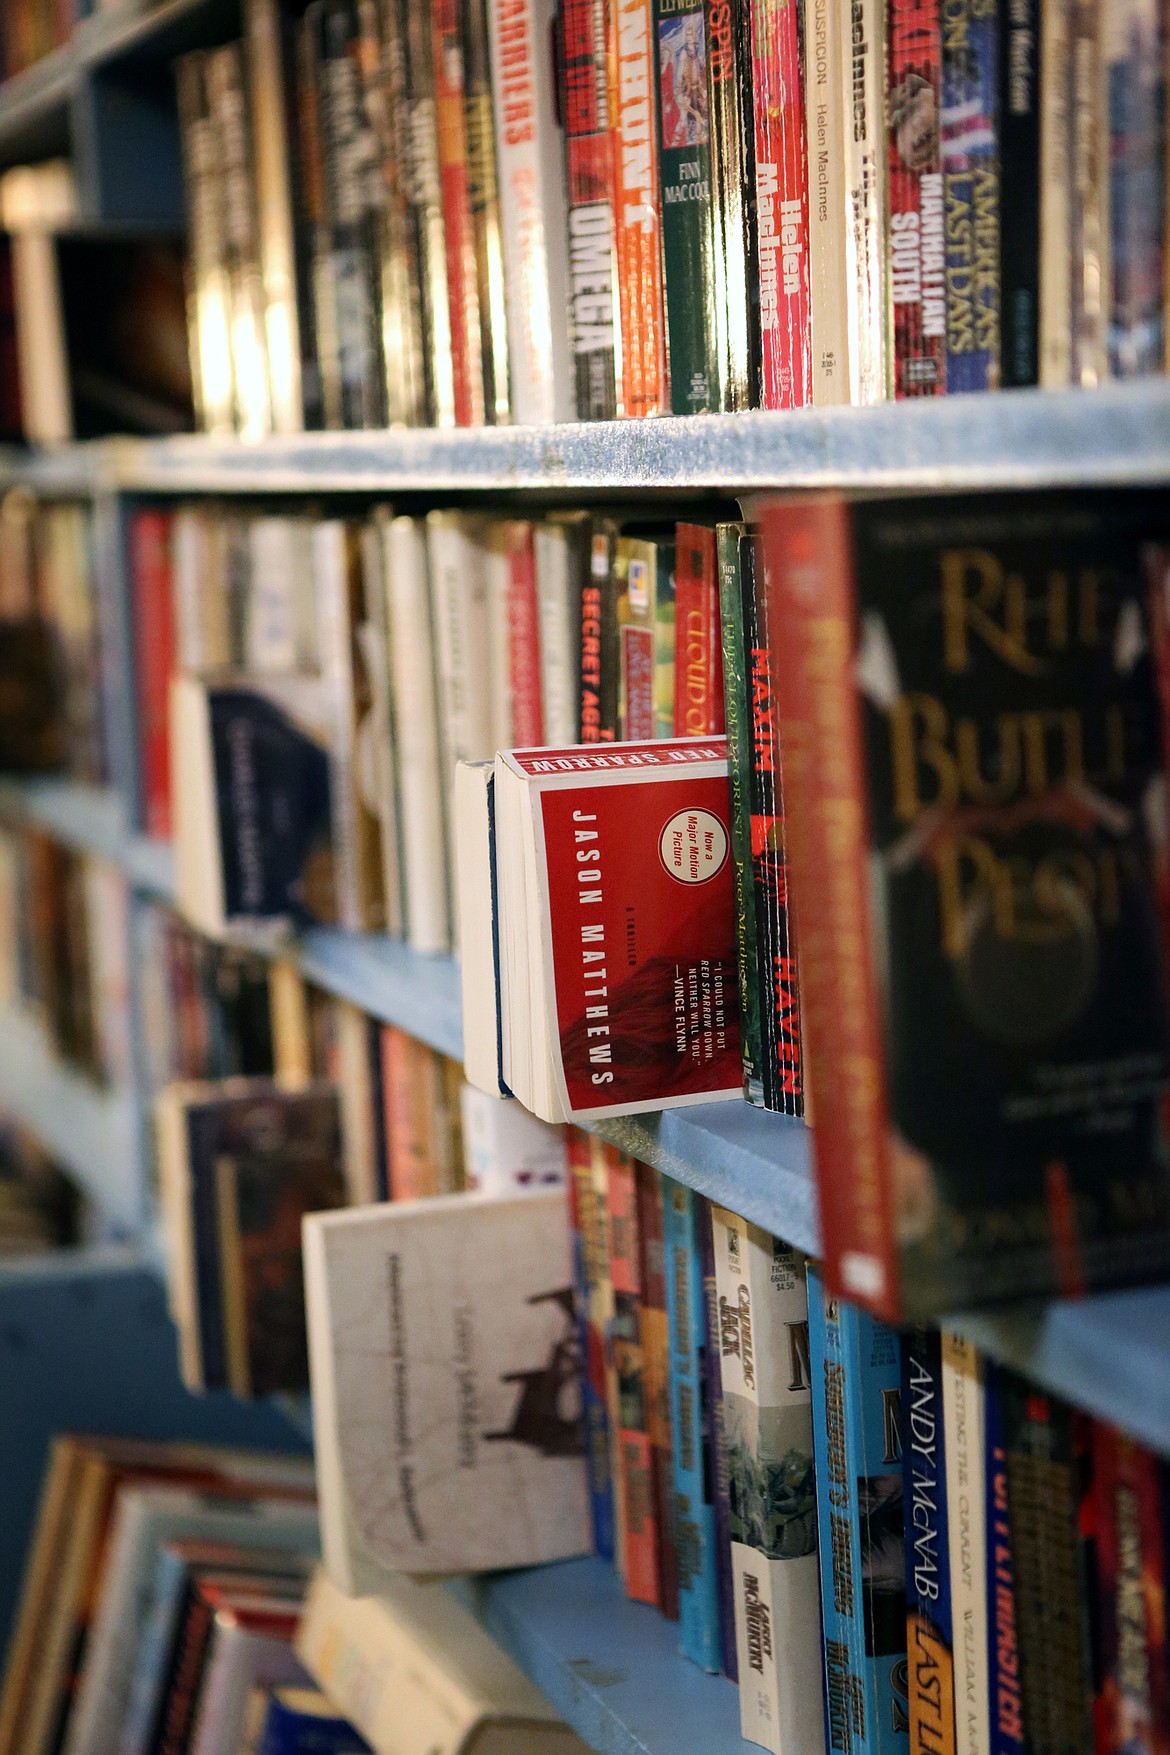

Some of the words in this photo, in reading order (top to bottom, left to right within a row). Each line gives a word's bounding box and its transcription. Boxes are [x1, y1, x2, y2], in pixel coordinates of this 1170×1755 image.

[709, 0, 732, 81] SPIN
[814, 0, 828, 85] SUSPICION
[817, 103, 828, 147] Helen
[664, 184, 688, 204] MAC
[818, 151, 829, 222] MacInnes
[945, 173, 975, 262] LAST
[570, 204, 614, 353] OMEGA
[756, 162, 781, 330] MacInnes
[780, 199, 803, 295] Helen
[891, 211, 922, 304] SOUTH
[920, 172, 946, 337] MANHATTAN
[947, 266, 975, 354] DAYS
[581, 587, 600, 685] SECRET
[687, 610, 706, 704] CLOUD
[751, 648, 777, 771] MAXIM
[531, 753, 660, 772] SPARROW
[670, 749, 720, 761] RED
[572, 810, 603, 904] JASON
[672, 831, 683, 867] Picture
[687, 815, 697, 843] Major
[704, 831, 714, 852] Now
[689, 845, 700, 879] Motion
[735, 861, 744, 906] Peter
[688, 968, 698, 1009] NEITHER
[701, 960, 710, 979] RED
[714, 975, 723, 1006] COULD
[580, 924, 614, 1085] MATTHEWS
[675, 1016, 687, 1052] FLYNN
[690, 1011, 699, 1035] WILL
[702, 982, 712, 1029] SPARROW
[715, 1009, 725, 1028] NOT
[773, 955, 801, 1095] HAVEN
[704, 1031, 713, 1063] DOWN.
[716, 1031, 726, 1049] PUT
[771, 1263, 797, 1273] FICTION
[776, 1281, 795, 1291] $4.50
[720, 1295, 741, 1360] JACK
[738, 1283, 756, 1392] CADILLAC
[823, 1359, 850, 1509] SOMEBODY'S
[909, 1355, 937, 1469] ANDY
[957, 1451, 969, 1488] THE
[829, 1510, 854, 1619] DARLING
[912, 1468, 940, 1601] McNAB
[759, 1601, 773, 1662] LARRY
[914, 1624, 943, 1721] LAST
